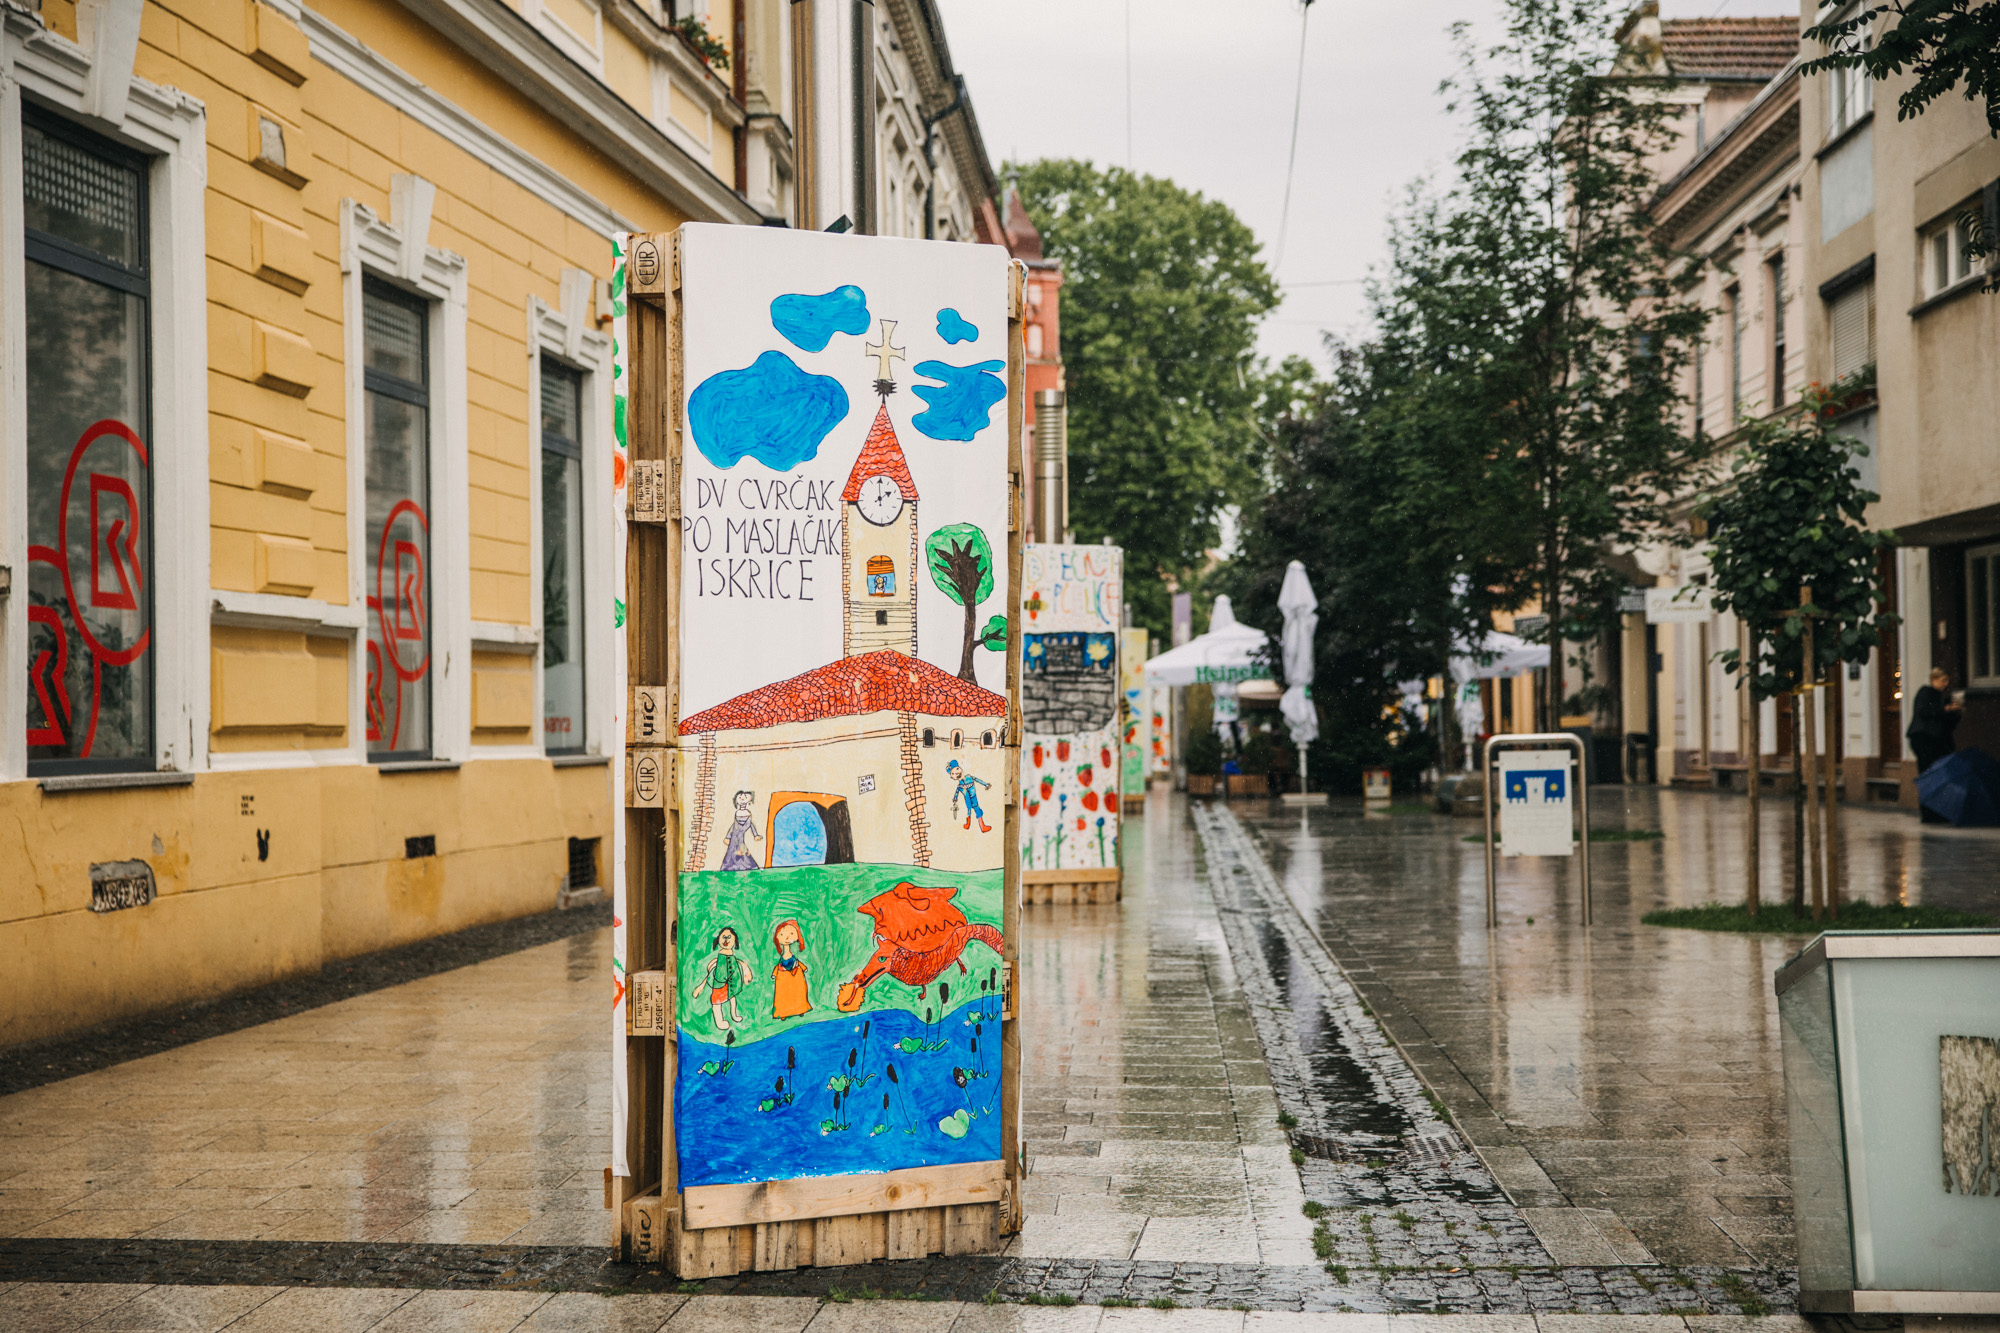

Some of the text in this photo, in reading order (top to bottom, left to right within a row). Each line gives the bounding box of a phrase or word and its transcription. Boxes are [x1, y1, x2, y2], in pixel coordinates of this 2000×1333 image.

[638, 251, 655, 276] EUR
[697, 478, 727, 509] DV
[738, 474, 835, 511] CVRČAK
[684, 514, 843, 555] PO MASLAČAK
[697, 558, 814, 601] ISKRICE
